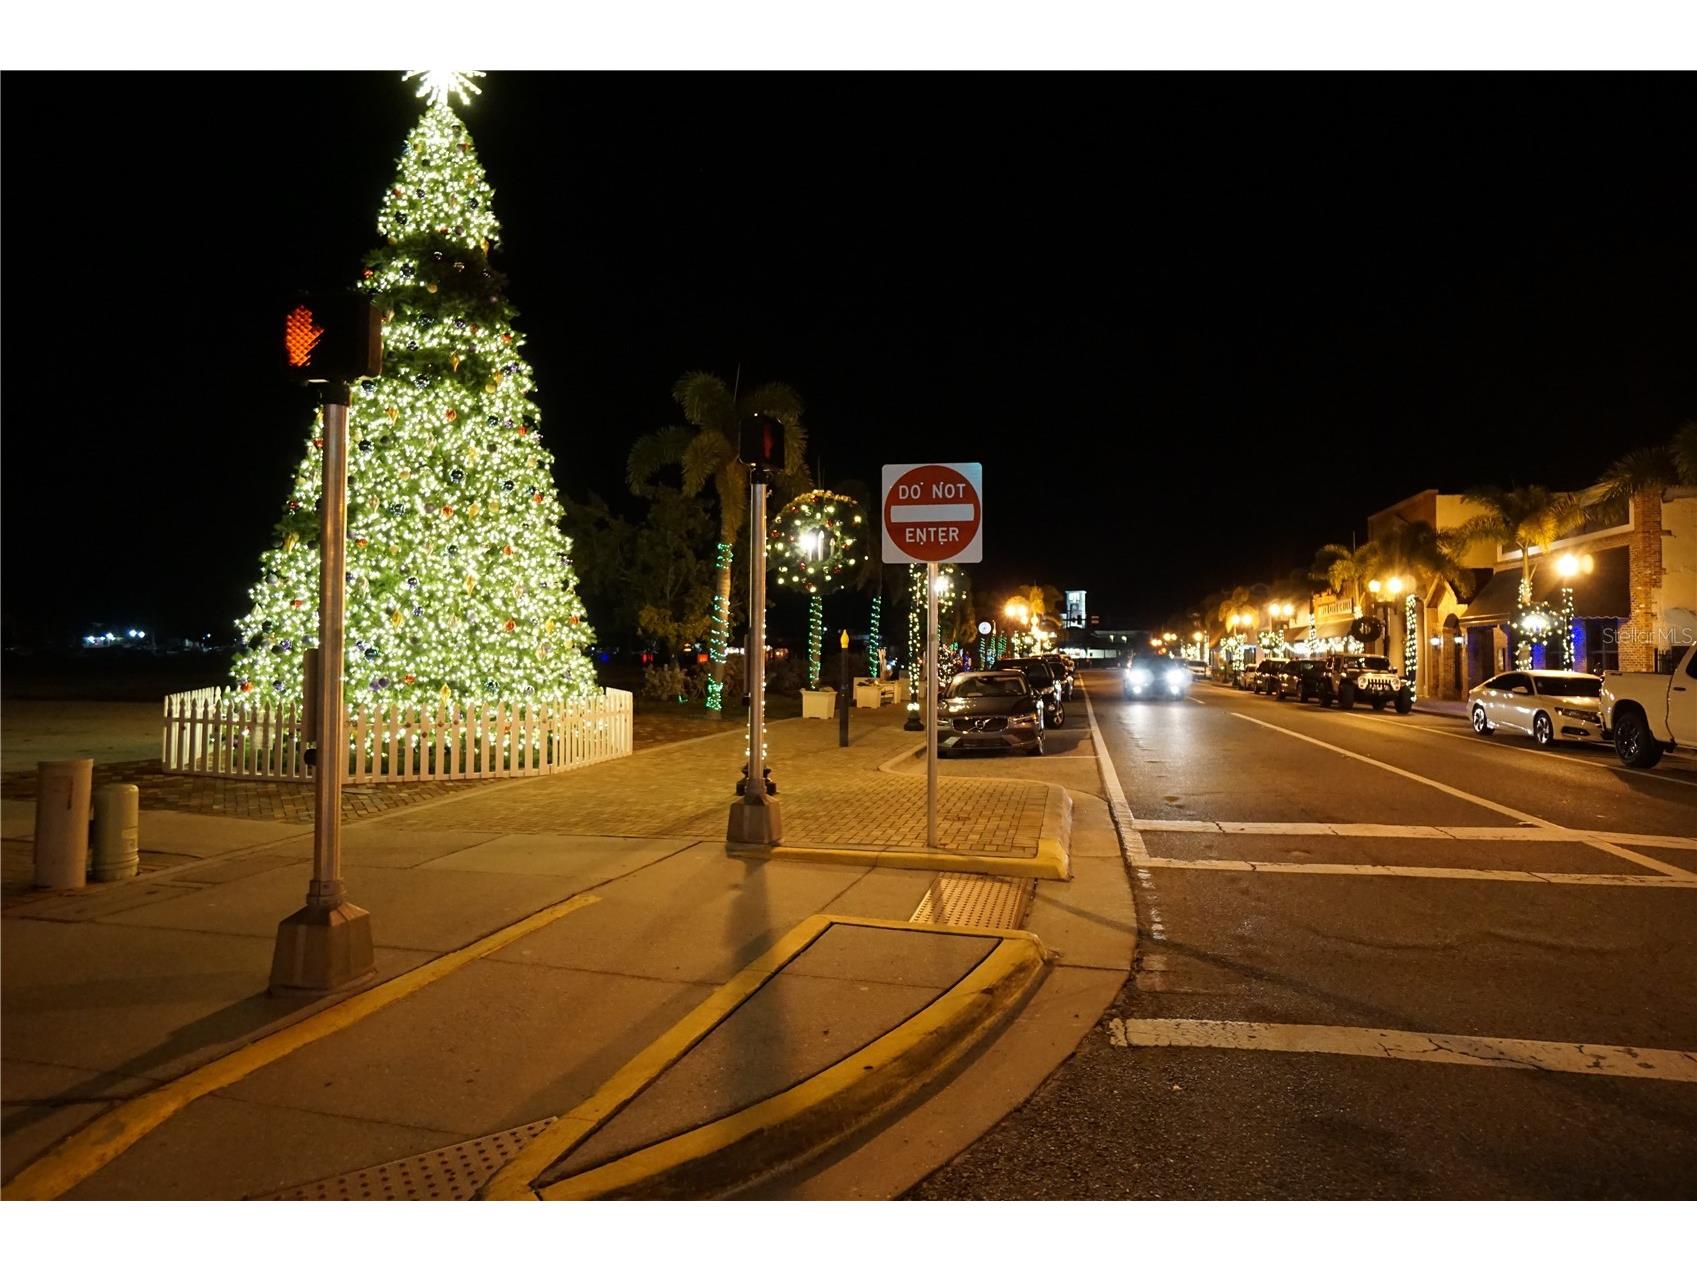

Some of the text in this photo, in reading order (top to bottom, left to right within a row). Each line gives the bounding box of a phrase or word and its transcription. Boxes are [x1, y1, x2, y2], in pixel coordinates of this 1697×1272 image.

[899, 484, 966, 499] DO NOT
[905, 528, 959, 542] ENTER
